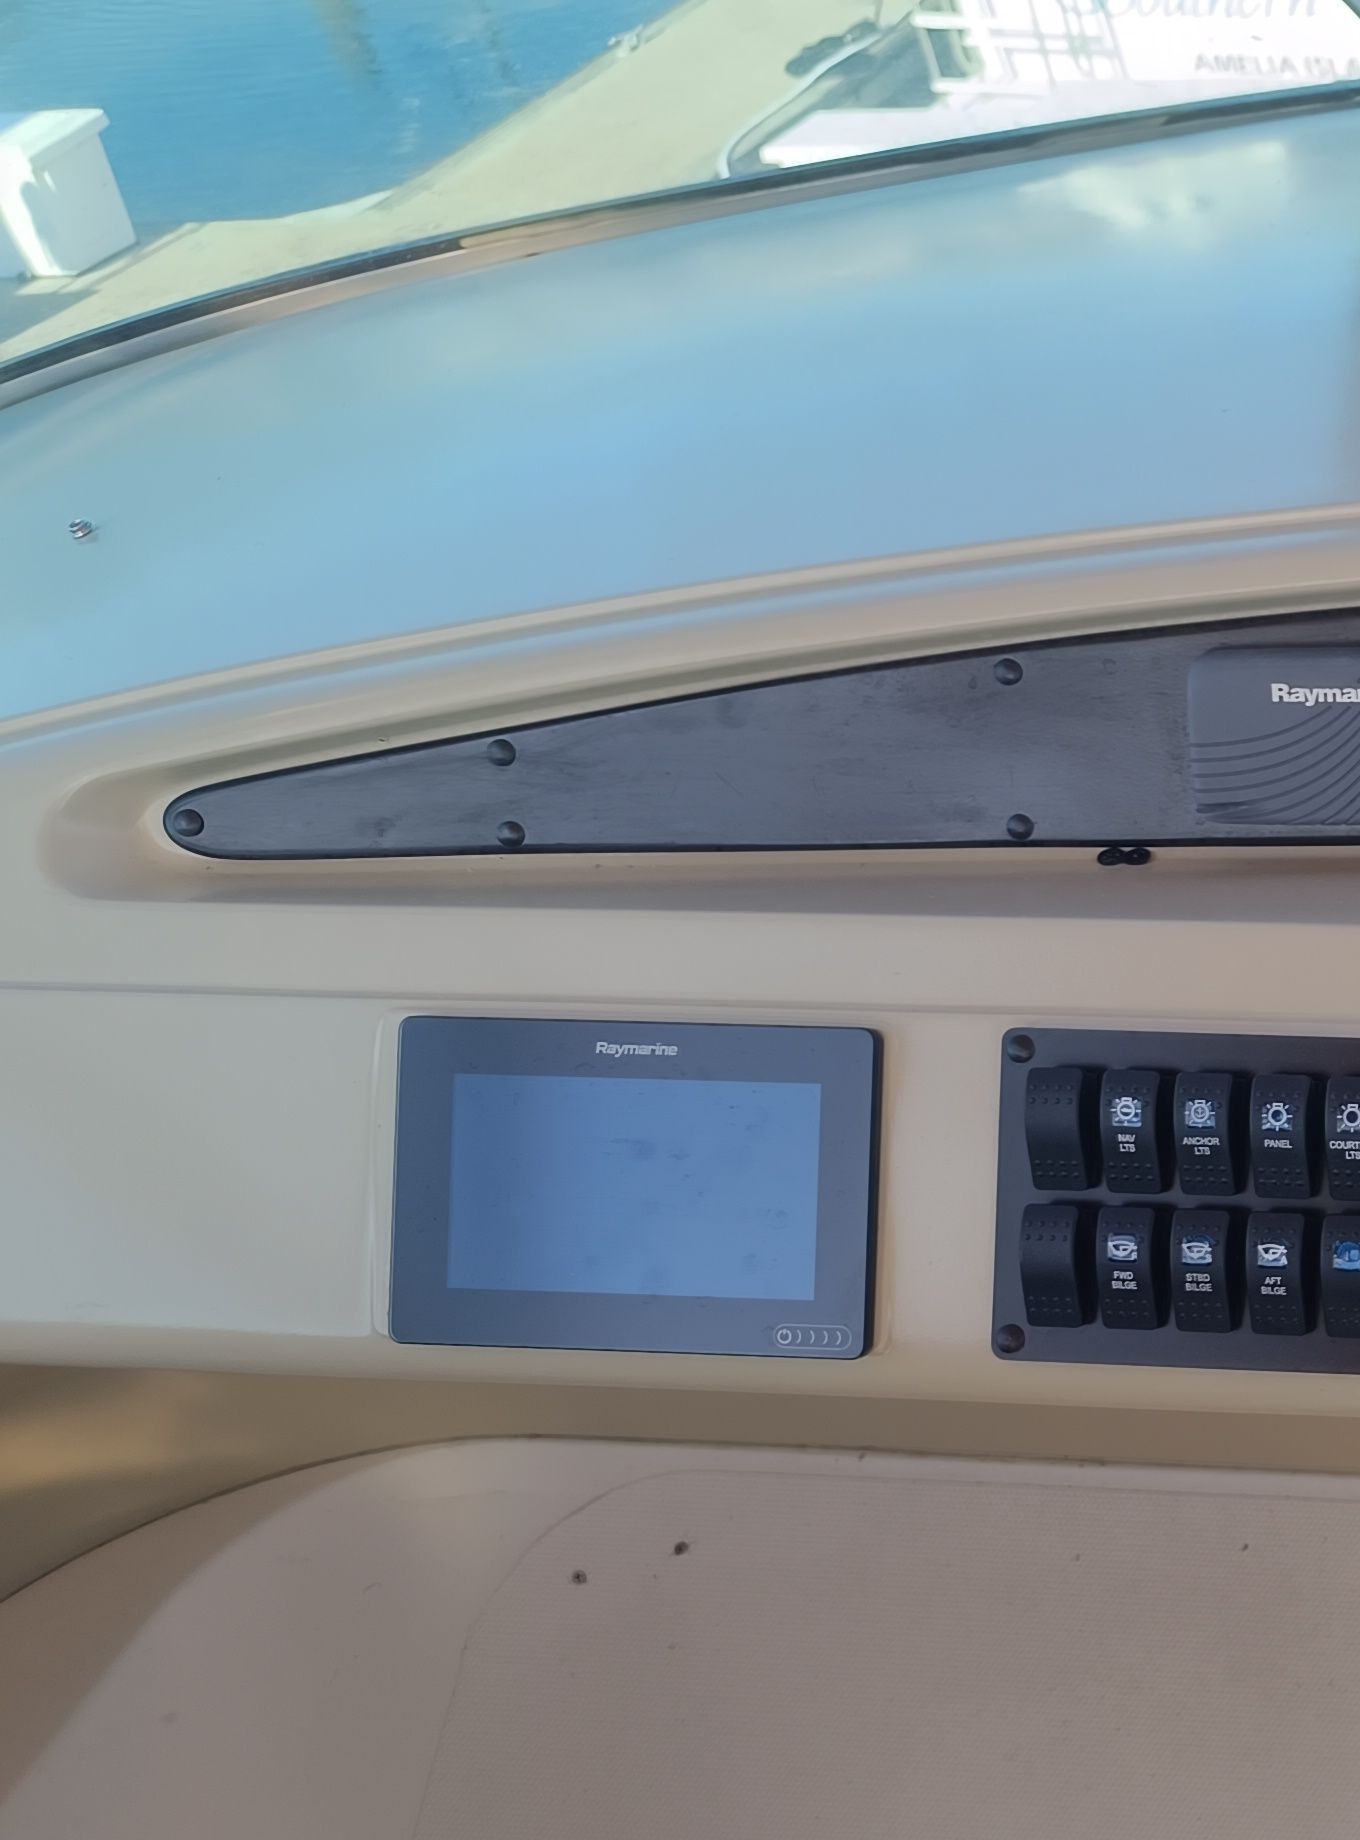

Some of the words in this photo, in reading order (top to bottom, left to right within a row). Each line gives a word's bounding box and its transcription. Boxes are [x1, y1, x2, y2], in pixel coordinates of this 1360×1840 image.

[595, 1040, 679, 1058] Raymarine
[1117, 1133, 1136, 1143] NAV
[1182, 1136, 1220, 1147] ANCHOR
[1263, 1138, 1293, 1149] PANEL
[1119, 1143, 1136, 1153] LTS
[1194, 1146, 1211, 1156] LTS
[1112, 1270, 1134, 1280] FWD
[1185, 1272, 1211, 1283] STBD
[1111, 1280, 1138, 1291] BILGE
[1264, 1276, 1282, 1286] AFT
[1185, 1282, 1213, 1293] BILGE
[1260, 1285, 1287, 1296] BILGE
